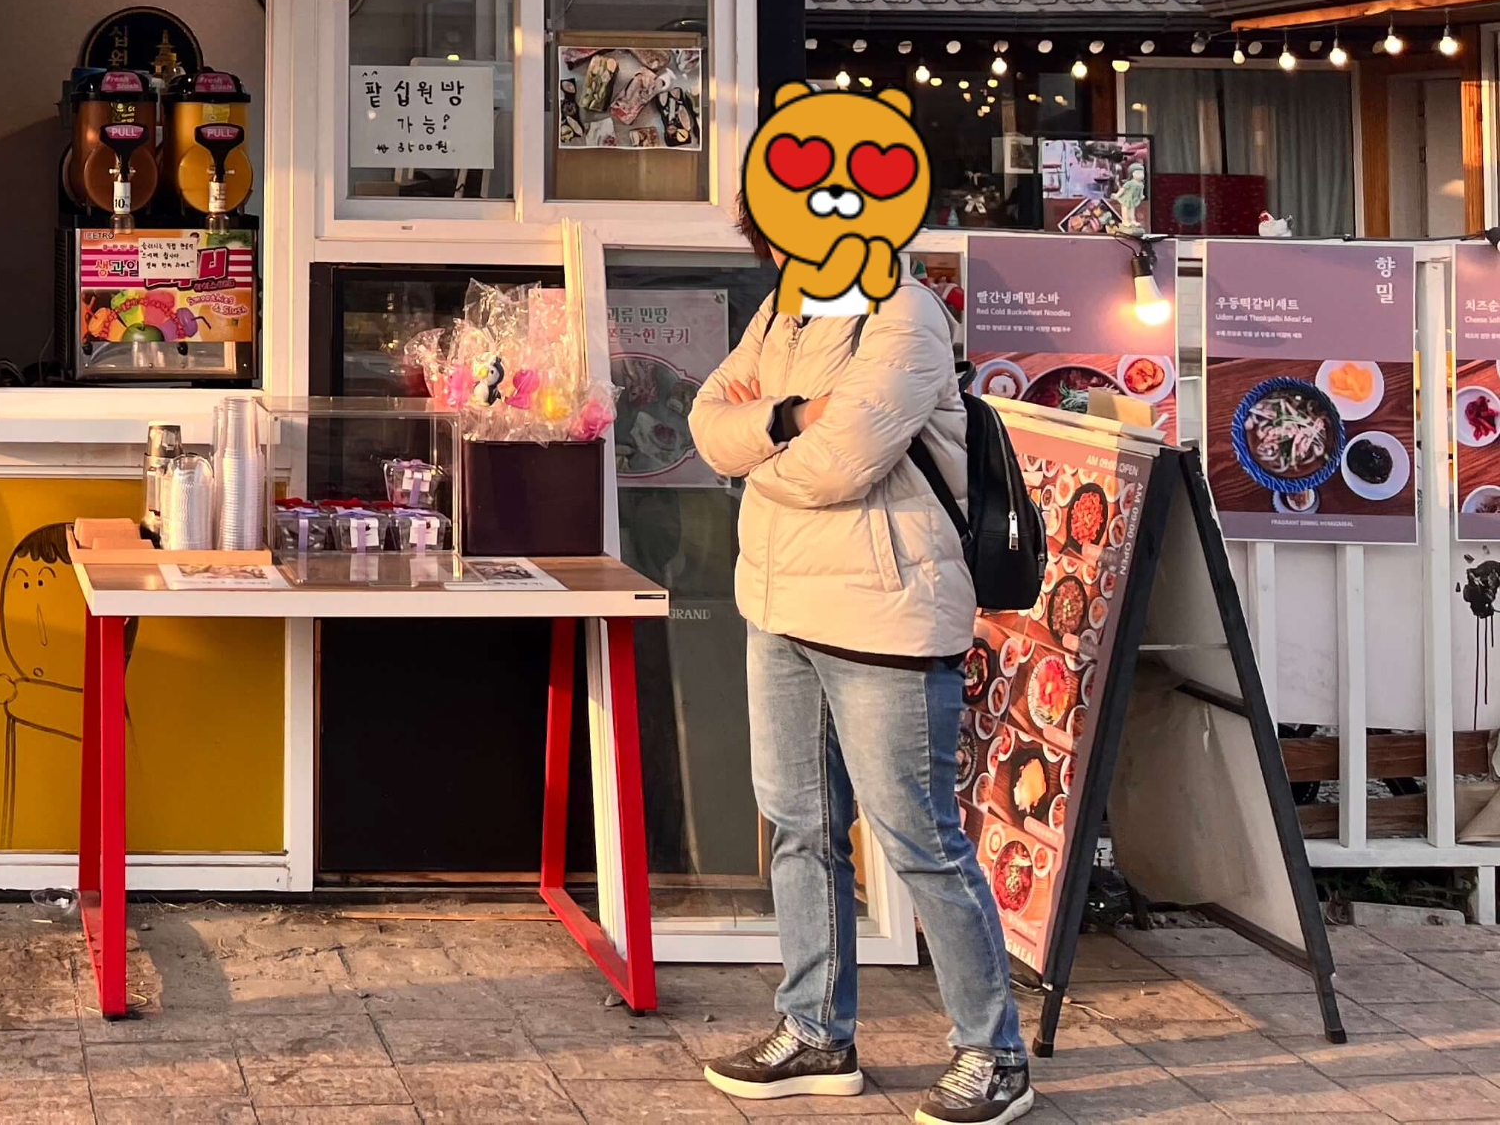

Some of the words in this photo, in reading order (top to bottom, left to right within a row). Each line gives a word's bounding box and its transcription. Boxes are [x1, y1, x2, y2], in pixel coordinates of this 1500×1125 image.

[111, 127, 138, 137] PULL
[206, 128, 233, 138] PULL
[1374, 255, 1397, 305] 향밀
[1215, 296, 1300, 311] 우동떡갈비세트
[976, 307, 989, 316] Red
[990, 308, 1006, 316] Cold
[1043, 309, 1071, 318] Noodles
[662, 327, 690, 345] 쿠키
[1118, 462, 1140, 477] OPEN
[1119, 542, 1132, 576] OPEN
